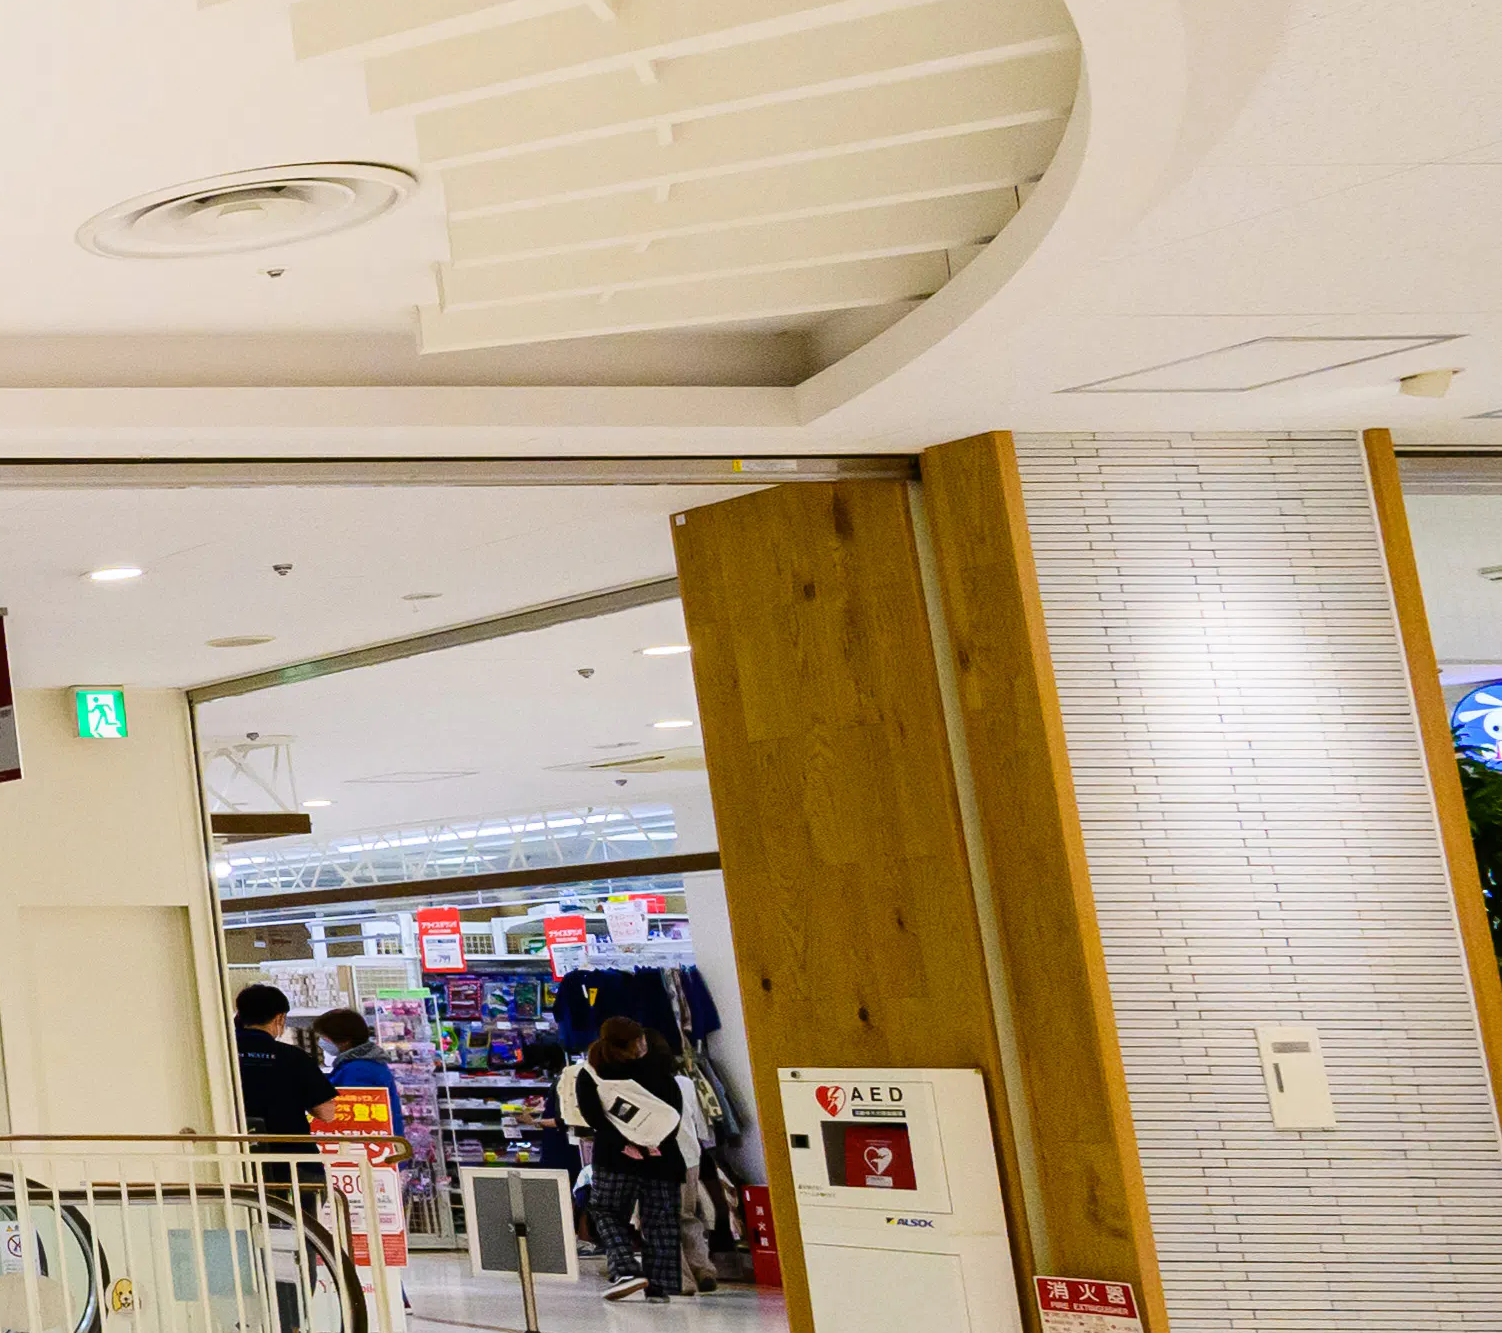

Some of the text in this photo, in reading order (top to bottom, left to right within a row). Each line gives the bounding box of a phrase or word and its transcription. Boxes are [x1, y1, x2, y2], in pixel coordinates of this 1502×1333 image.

[851, 1086, 903, 1102] AED
[897, 1218, 935, 1229] ALSOK
[1046, 1280, 1127, 1305] 消火器
